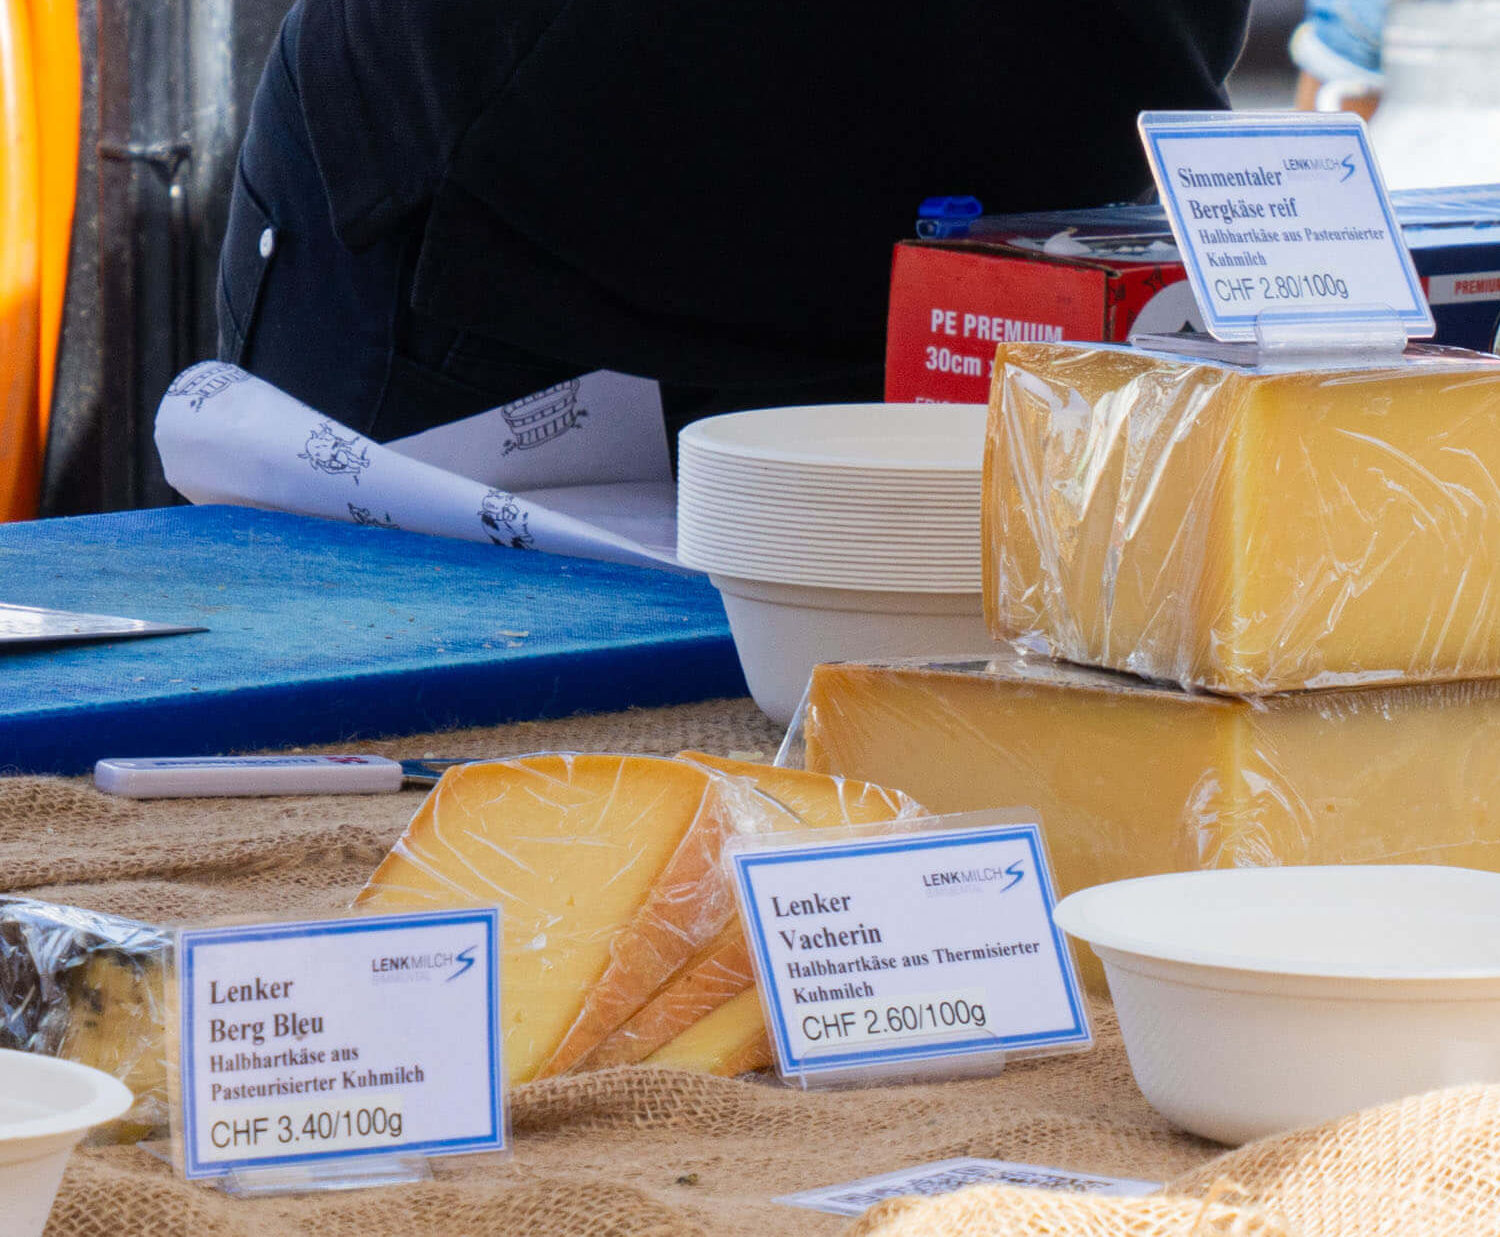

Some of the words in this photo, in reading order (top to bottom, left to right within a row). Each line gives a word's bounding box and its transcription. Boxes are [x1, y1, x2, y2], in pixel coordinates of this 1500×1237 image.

[1178, 167, 1283, 189] Simmentaler
[1190, 199, 1264, 224] Bergkäse
[1268, 196, 1298, 218] reif
[1199, 227, 1280, 245] Halbhartkäse
[1283, 230, 1303, 243] aus
[1305, 227, 1385, 243] Pasteurisierter
[1206, 251, 1268, 268] Kuhmilch
[1214, 277, 1255, 303] CHF
[1260, 273, 1350, 300] 2.80/100g
[931, 309, 957, 336] PE
[963, 313, 1063, 343] PREMIUM
[926, 346, 981, 377] 30cm
[922, 867, 1003, 887] LENKMILCH
[772, 892, 851, 918] Lenker
[779, 924, 882, 951] Vacherin
[371, 952, 453, 972] LENKMILCH
[786, 955, 898, 979] Halbhartkäse
[901, 951, 929, 968] aus
[933, 940, 1041, 965] Thermisierter
[209, 978, 294, 1004] Lenker
[792, 982, 874, 1004] Kuhmilch
[209, 1017, 265, 1045] Berg
[273, 1013, 323, 1038] Bleu
[802, 1012, 857, 1042] CHF
[864, 999, 987, 1034] 2.60/100g
[209, 1049, 325, 1073] Halbhartkäse
[331, 1047, 359, 1063] aus
[211, 1072, 336, 1101] Pasteurisierter
[342, 1066, 424, 1089] Kuhmilch
[210, 1117, 268, 1149] CHF
[277, 1106, 403, 1143] 3.40/100g
